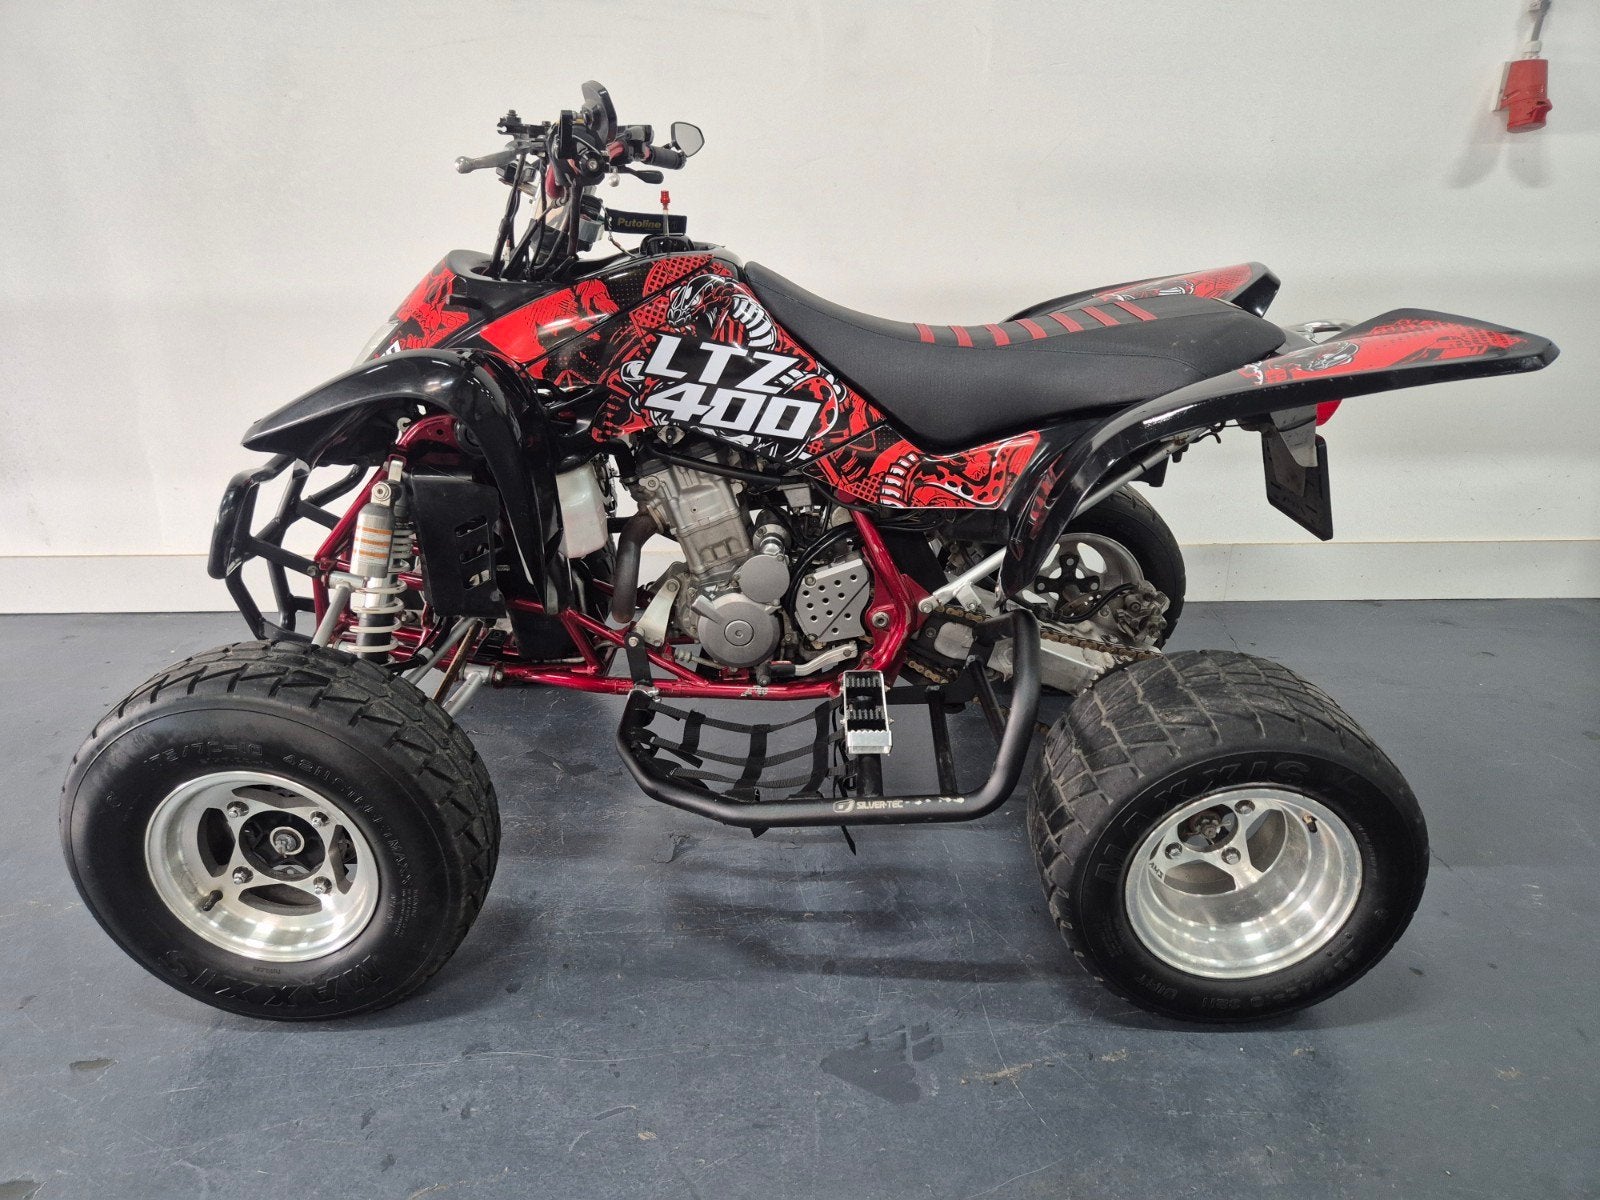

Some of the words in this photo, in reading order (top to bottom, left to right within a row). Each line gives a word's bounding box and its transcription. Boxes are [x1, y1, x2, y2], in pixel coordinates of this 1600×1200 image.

[617, 217, 662, 229] Putoline
[645, 334, 799, 394] LTZ
[645, 383, 820, 440] 400
